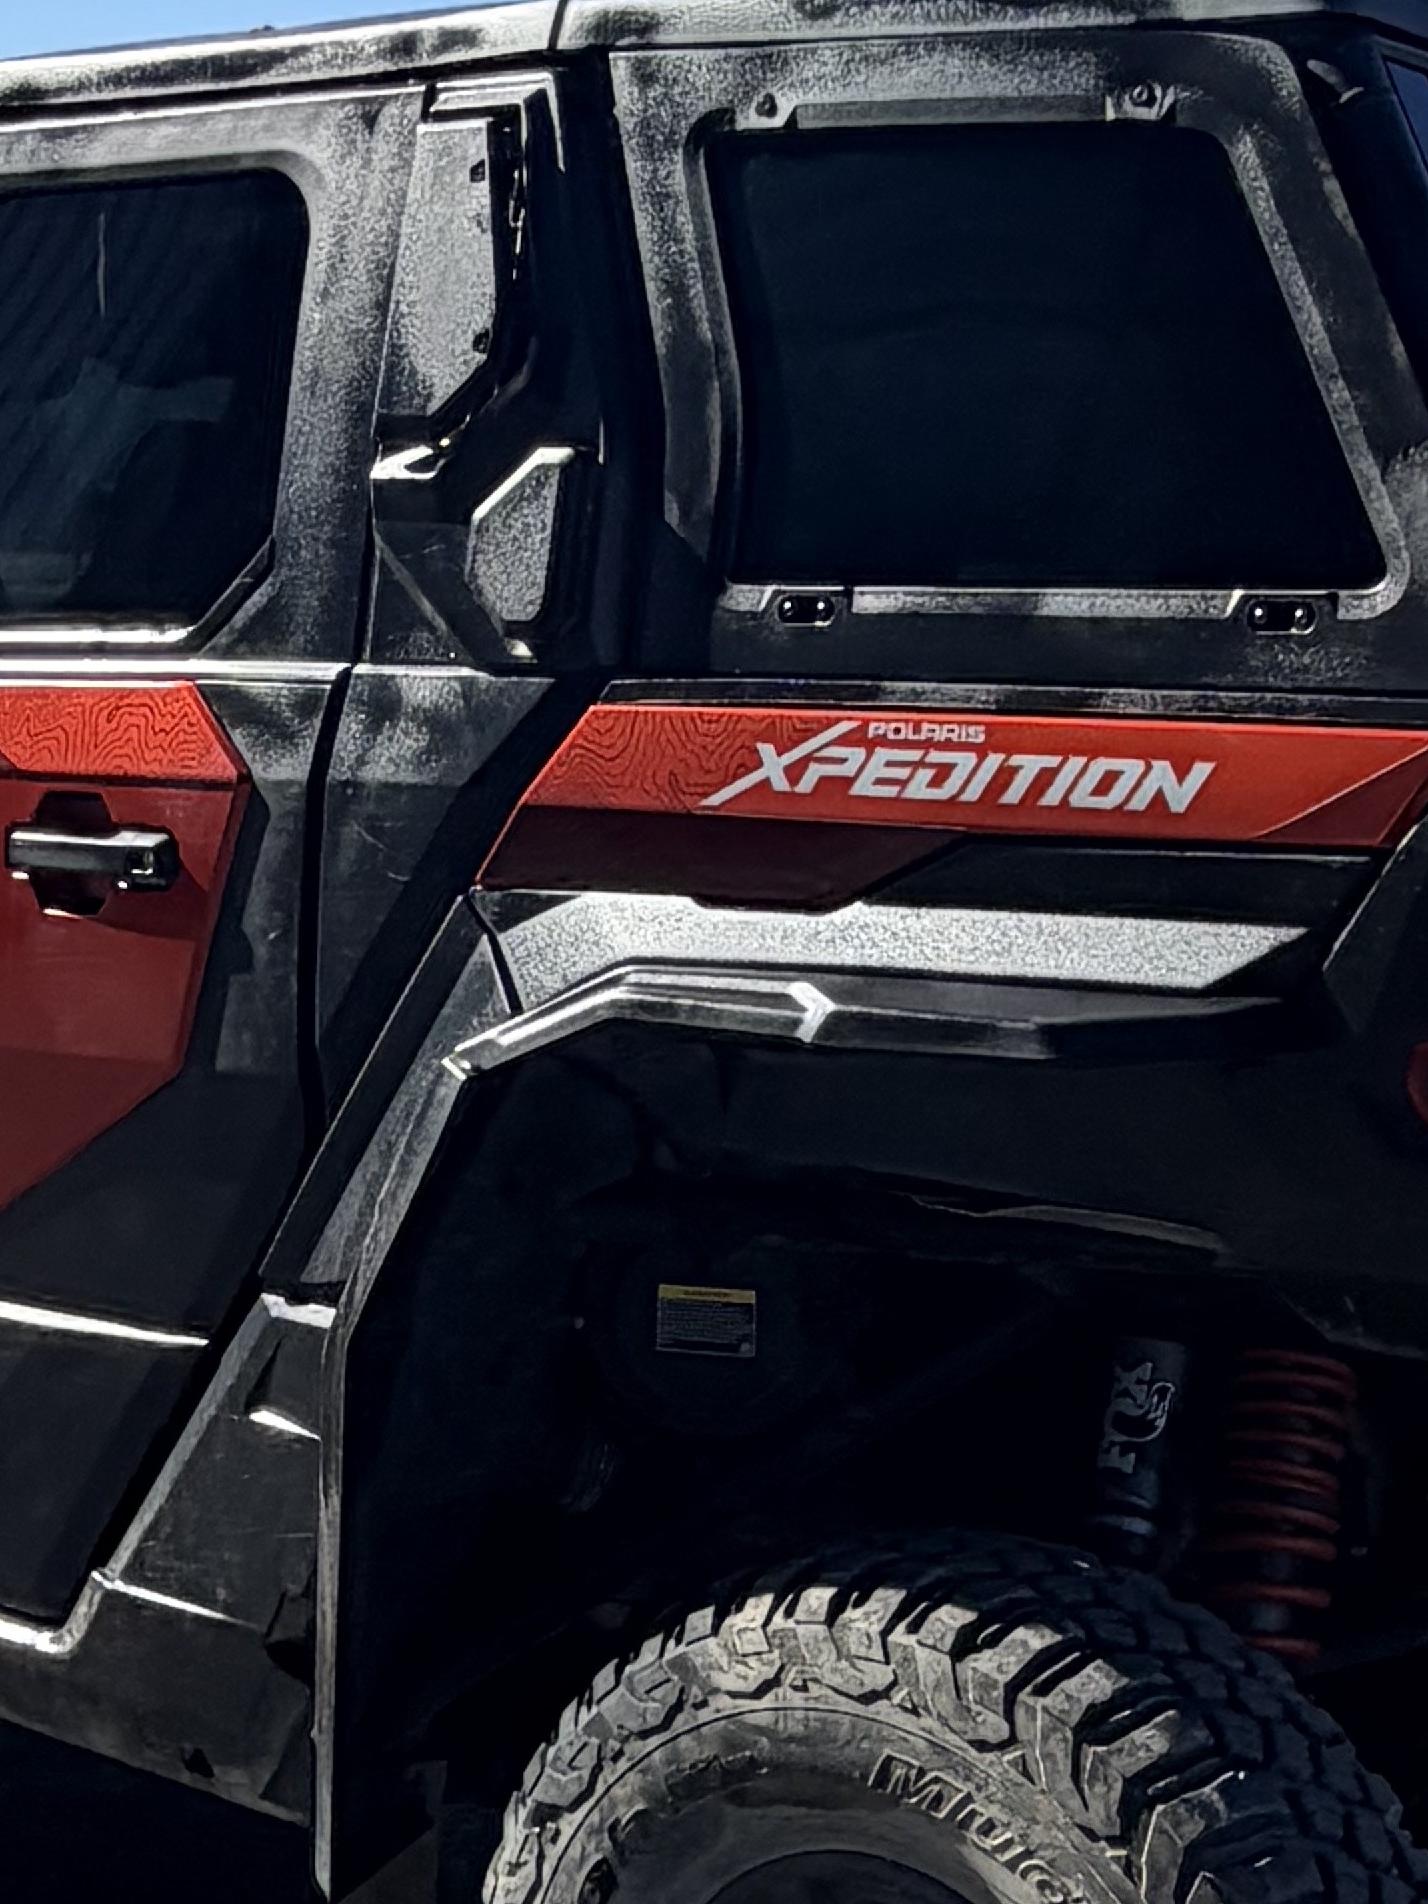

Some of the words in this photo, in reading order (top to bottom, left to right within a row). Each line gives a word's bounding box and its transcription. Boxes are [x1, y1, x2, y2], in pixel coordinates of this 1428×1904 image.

[699, 719, 1216, 814] XPEDITION
[866, 720, 987, 745] POLARIS
[1096, 1361, 1176, 1475] FOX
